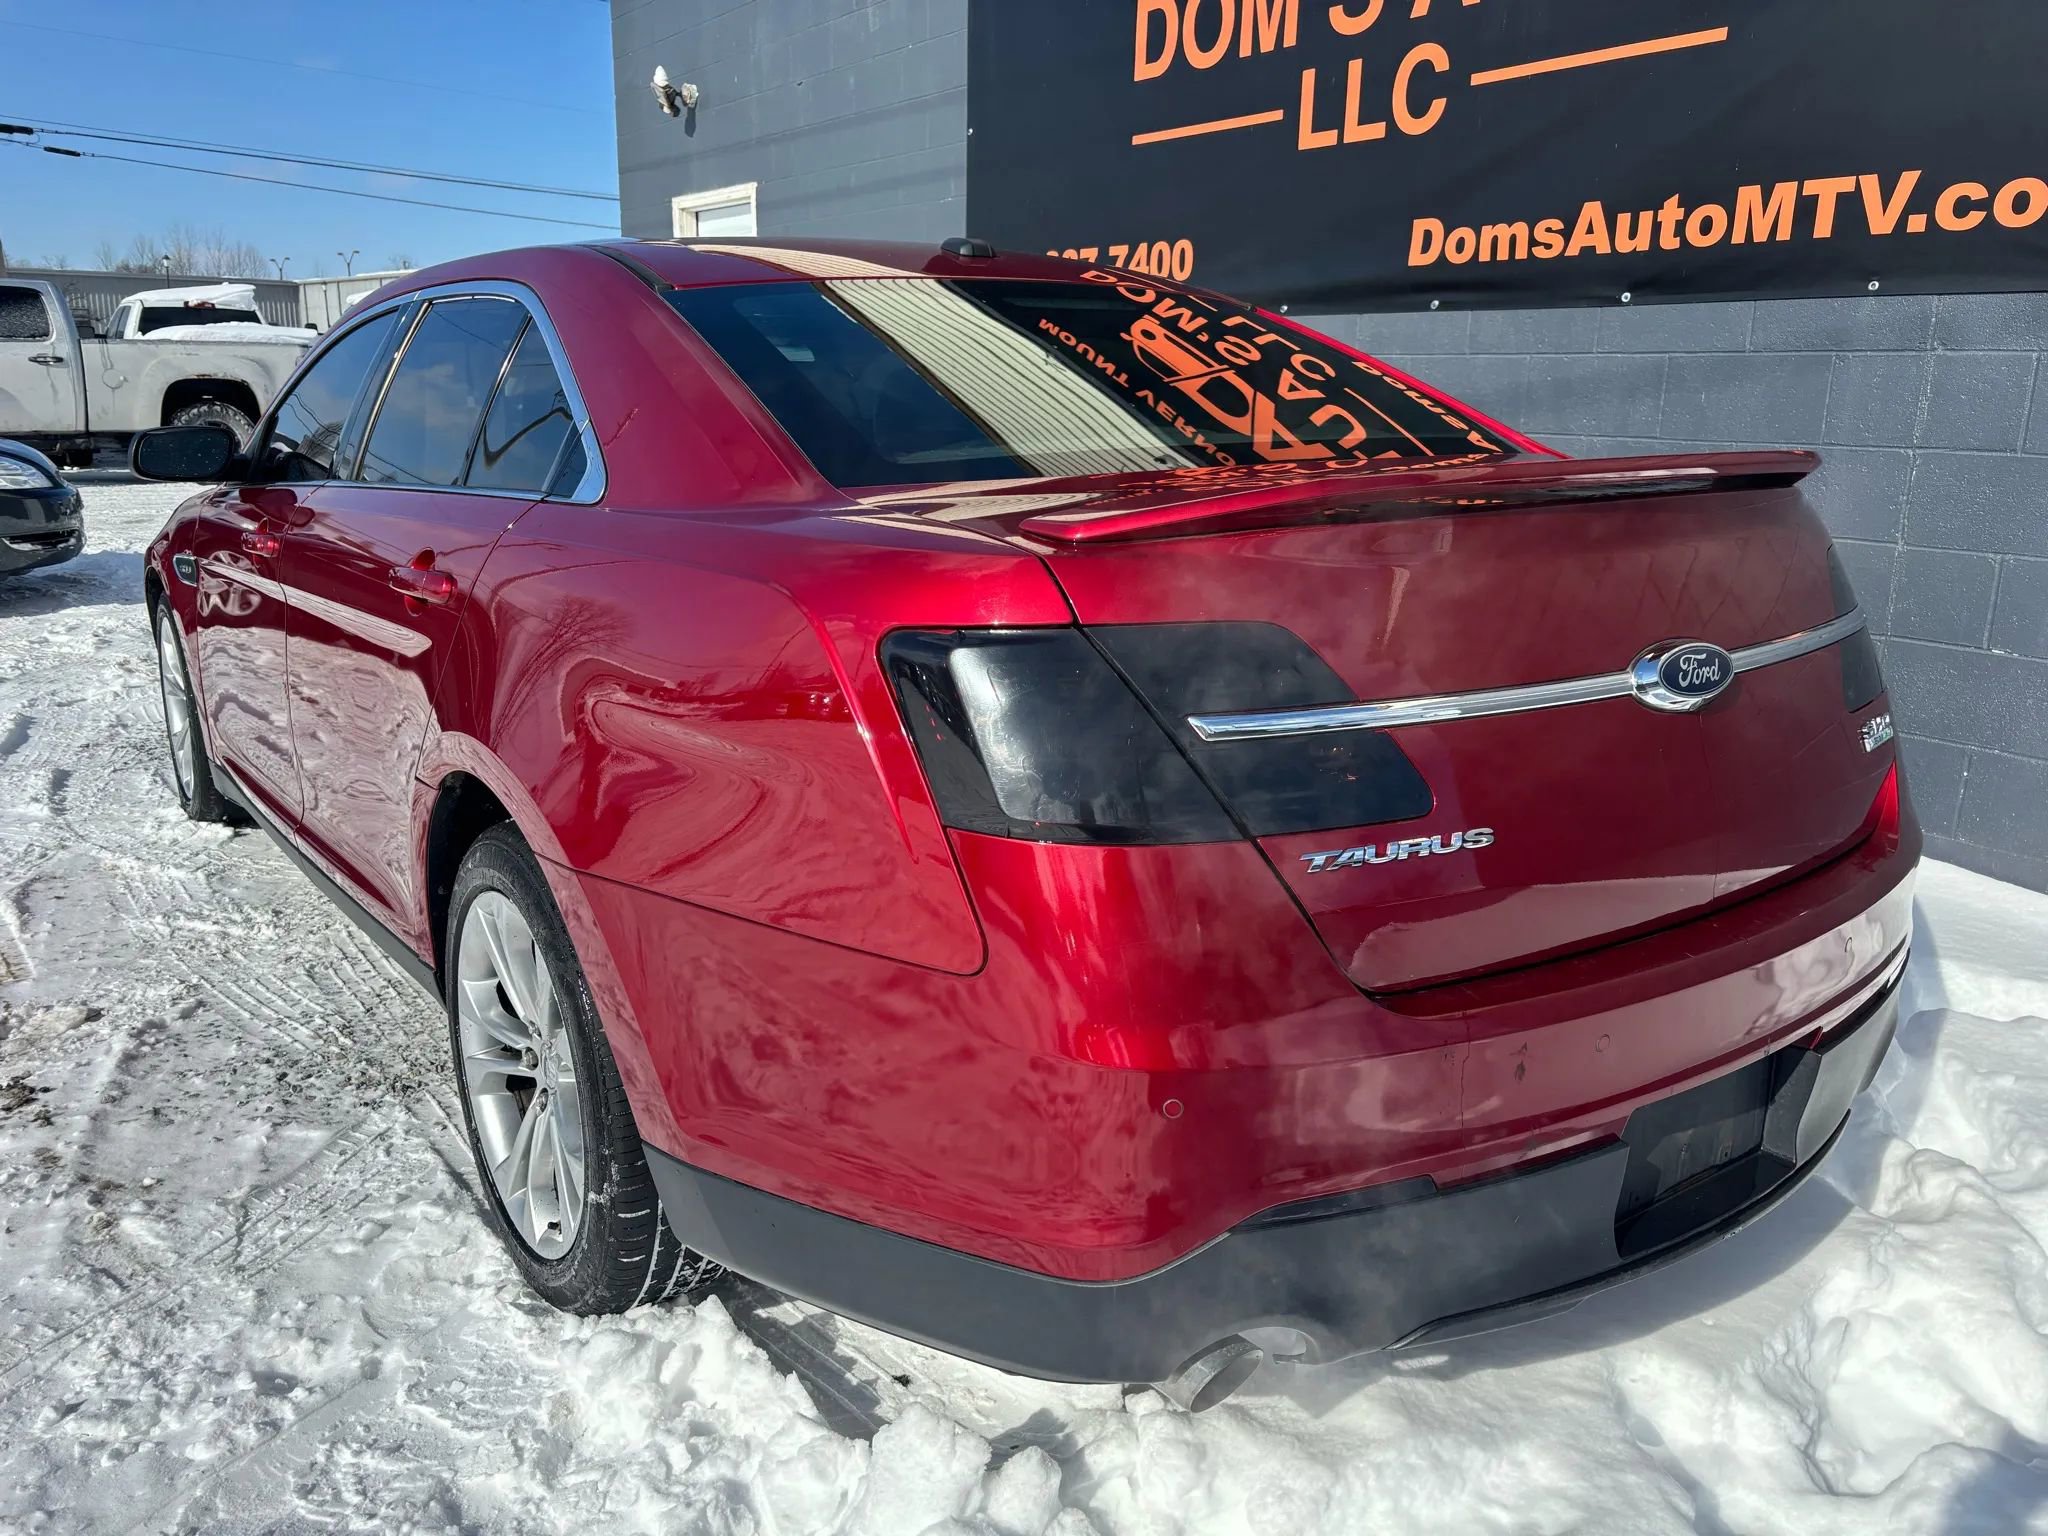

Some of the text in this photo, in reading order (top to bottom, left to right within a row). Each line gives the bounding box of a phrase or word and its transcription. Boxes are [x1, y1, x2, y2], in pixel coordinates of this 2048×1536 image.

[1298, 42, 1450, 151] LLC
[1407, 169, 2048, 266] DomsAutoMTV.co
[1679, 653, 1721, 687] Ford
[1299, 827, 1495, 873] TAURUS
